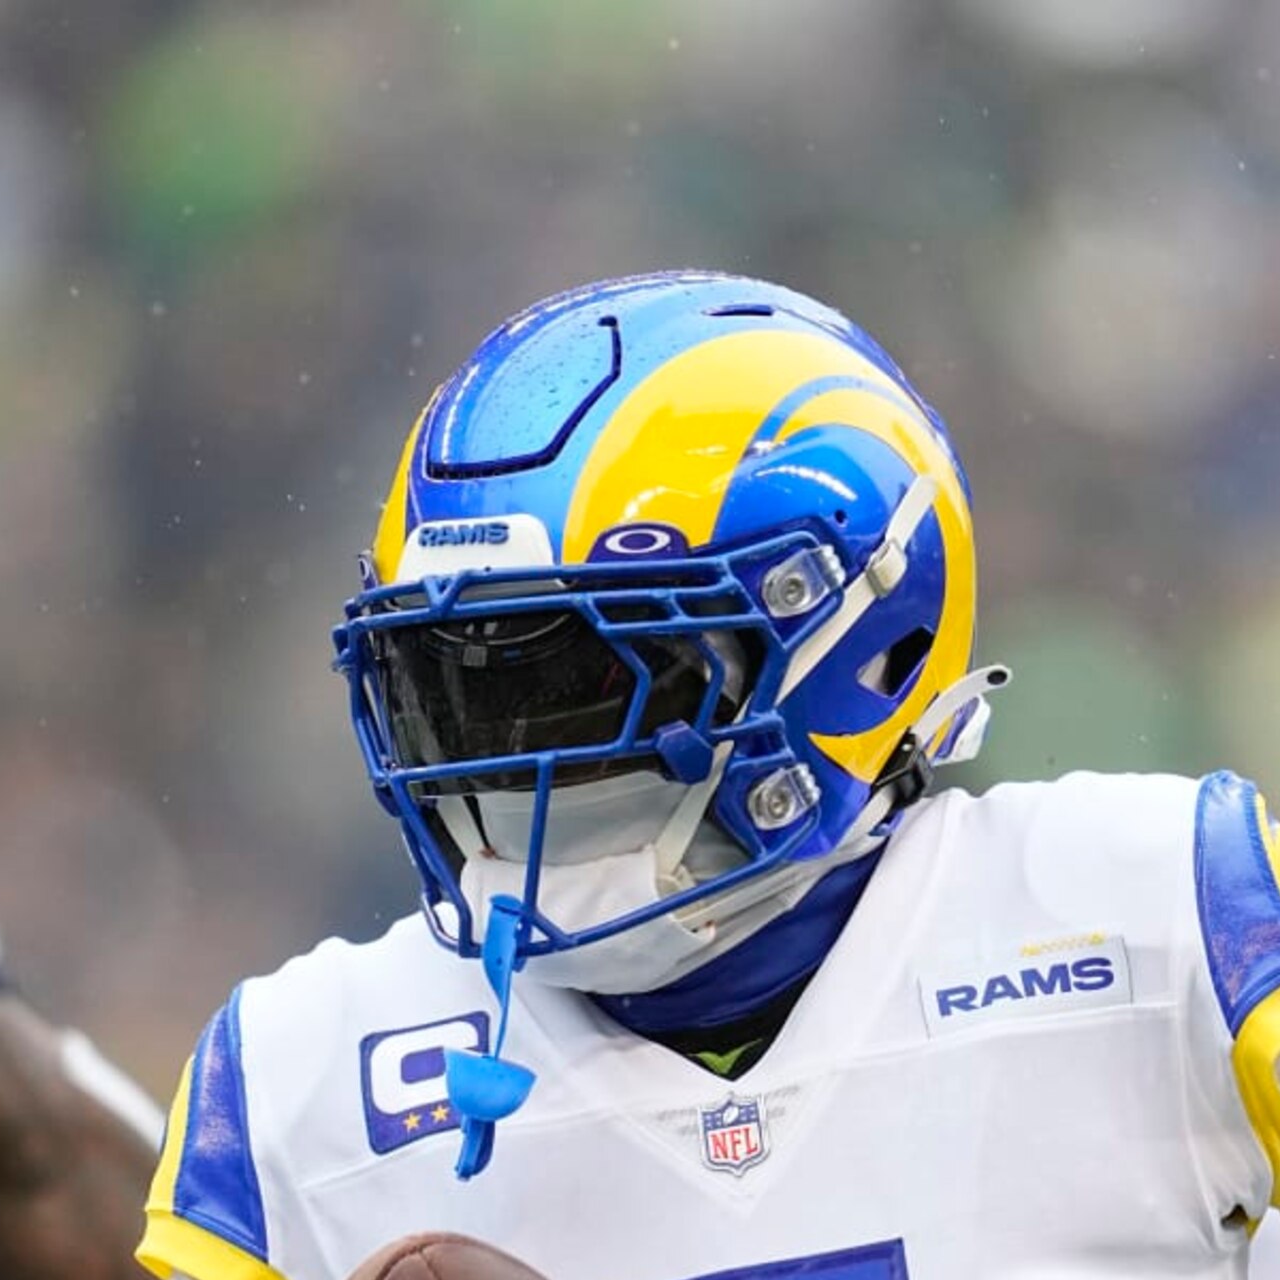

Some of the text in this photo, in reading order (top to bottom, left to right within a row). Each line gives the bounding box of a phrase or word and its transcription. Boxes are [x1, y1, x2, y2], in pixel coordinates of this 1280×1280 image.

[418, 522, 510, 547] RAMS
[935, 957, 1115, 1017] RAMS
[710, 1126, 758, 1161] NFL
